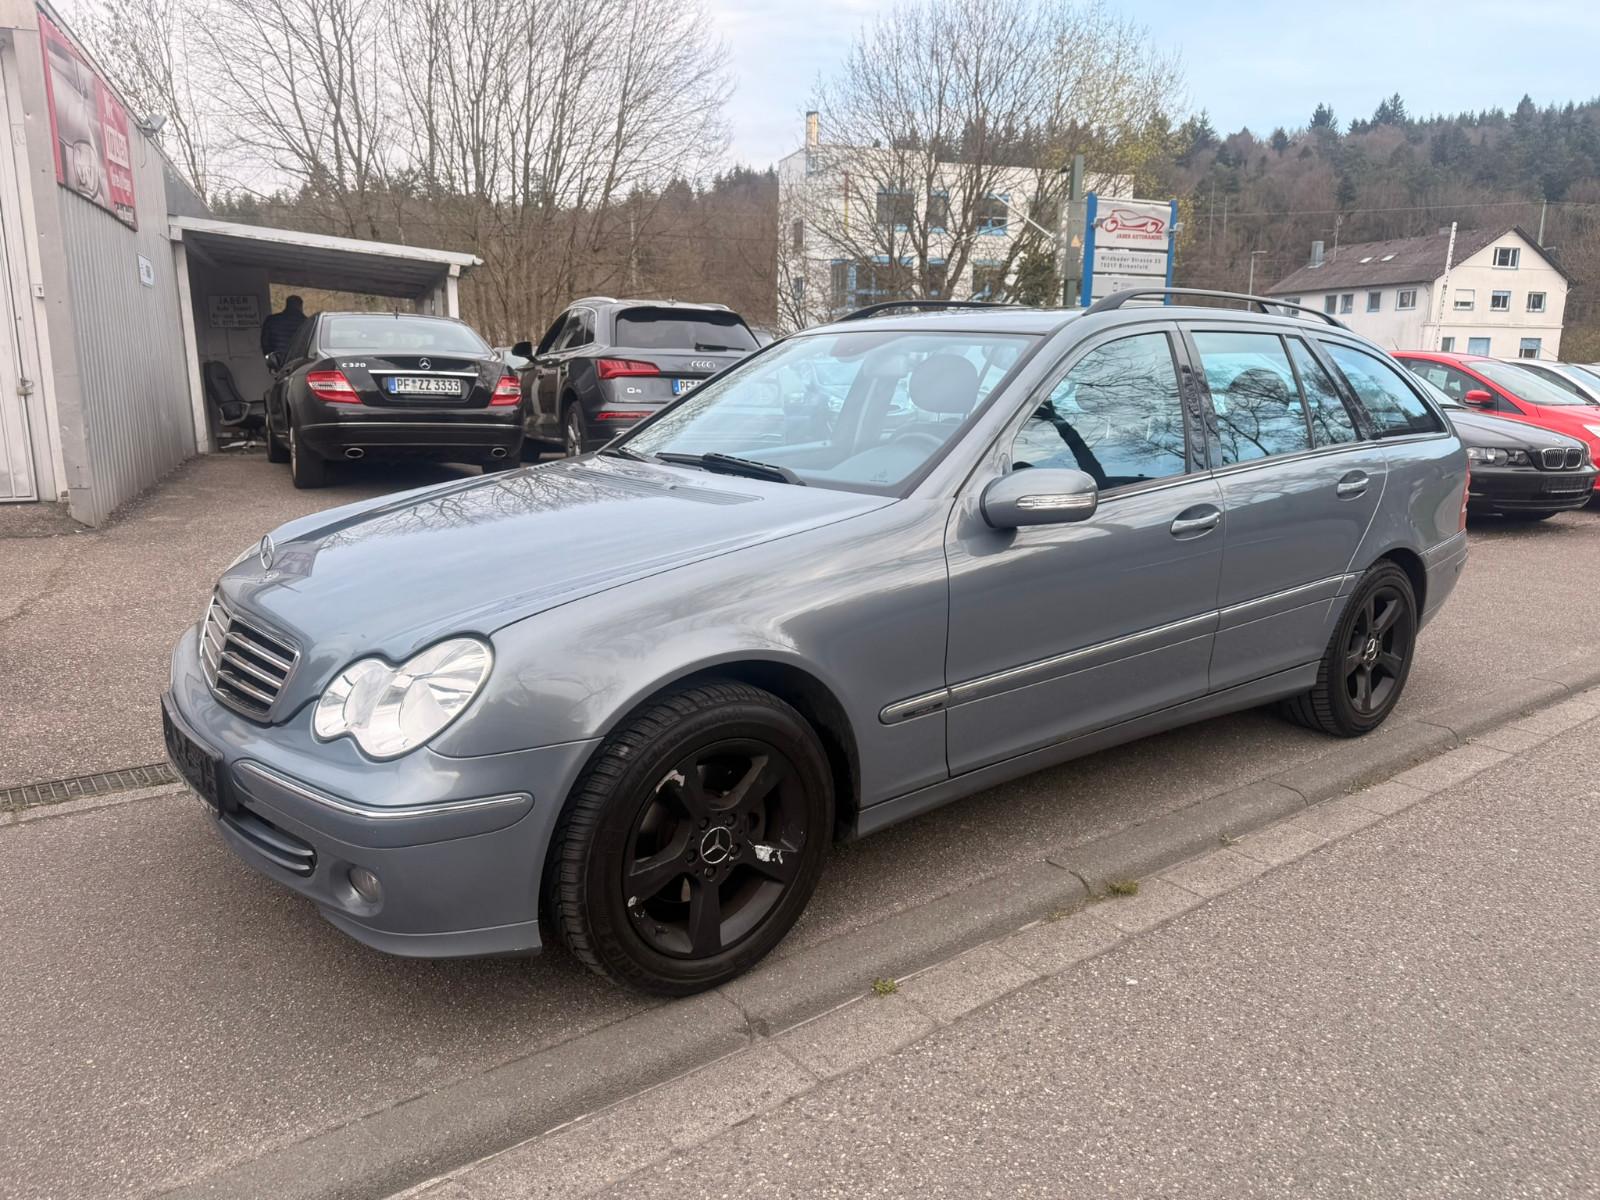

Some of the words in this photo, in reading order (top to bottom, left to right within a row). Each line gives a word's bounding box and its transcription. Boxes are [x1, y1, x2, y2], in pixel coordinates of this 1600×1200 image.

[397, 378, 411, 390] PF
[418, 379, 431, 391] ZZ
[434, 379, 460, 392] 3333
